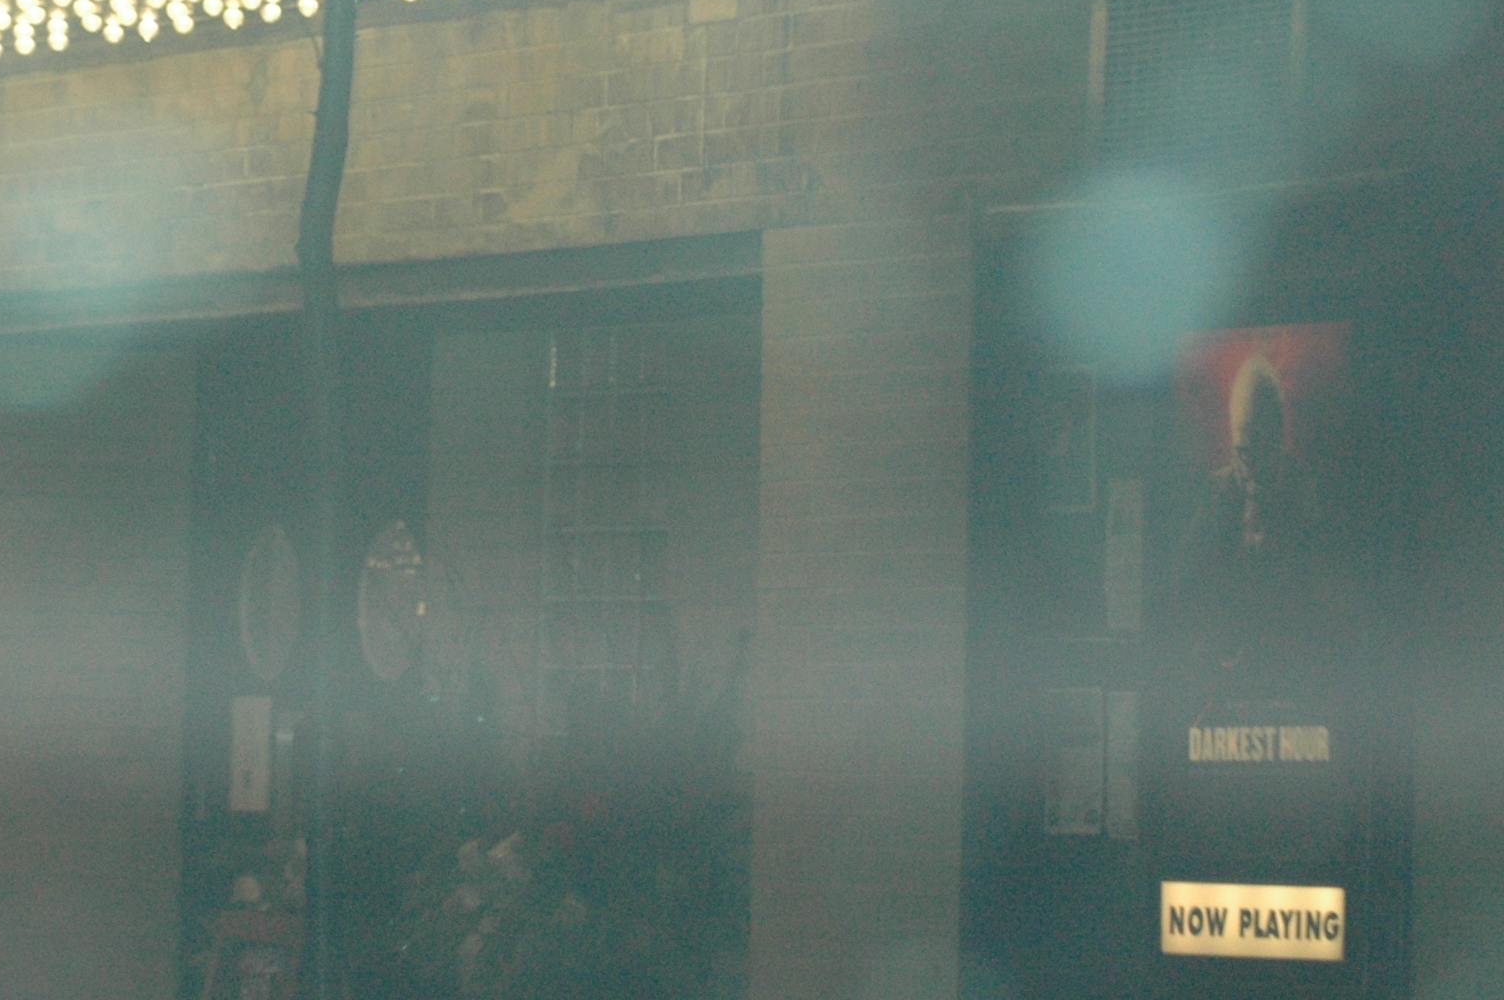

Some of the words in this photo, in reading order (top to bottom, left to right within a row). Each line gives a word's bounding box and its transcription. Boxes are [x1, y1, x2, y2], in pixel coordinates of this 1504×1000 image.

[1189, 727, 1277, 762] DARKEST
[1169, 906, 1228, 937] NOW
[1238, 908, 1341, 942] PLAYING
